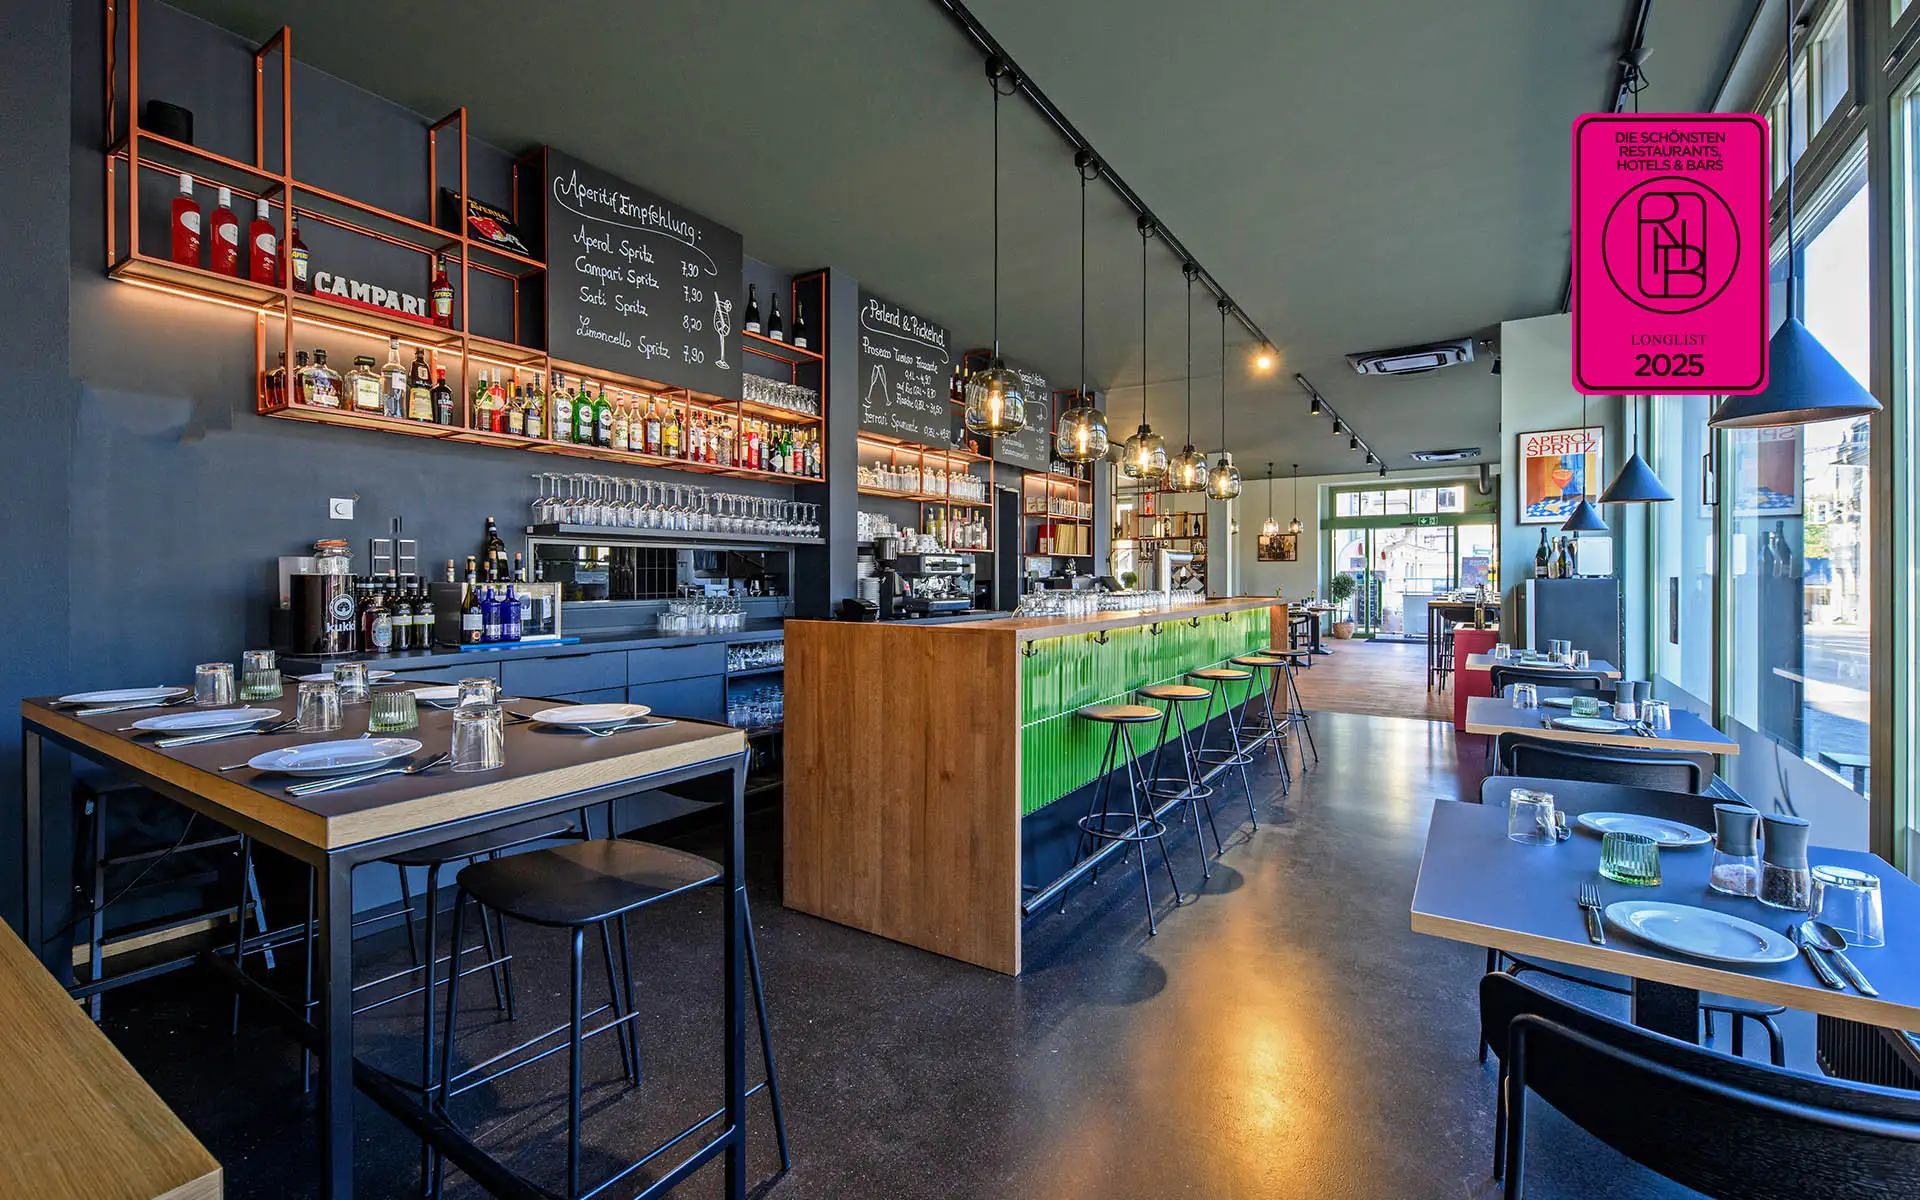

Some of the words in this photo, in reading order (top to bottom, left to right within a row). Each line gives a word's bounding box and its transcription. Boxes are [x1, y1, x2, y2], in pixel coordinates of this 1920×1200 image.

[560, 169, 618, 213] Aperitif
[573, 224, 614, 253] Aperol
[618, 240, 654, 264] Spritz
[575, 256, 623, 286] Campari
[626, 269, 660, 289] Spritz
[314, 271, 426, 317] CAMPARI
[615, 295, 649, 317] Spritz
[576, 315, 632, 348] Limoncello
[637, 336, 671, 360] Spritz
[1526, 440, 1597, 457] SPRITZ
[1528, 432, 1593, 446] APEROL
